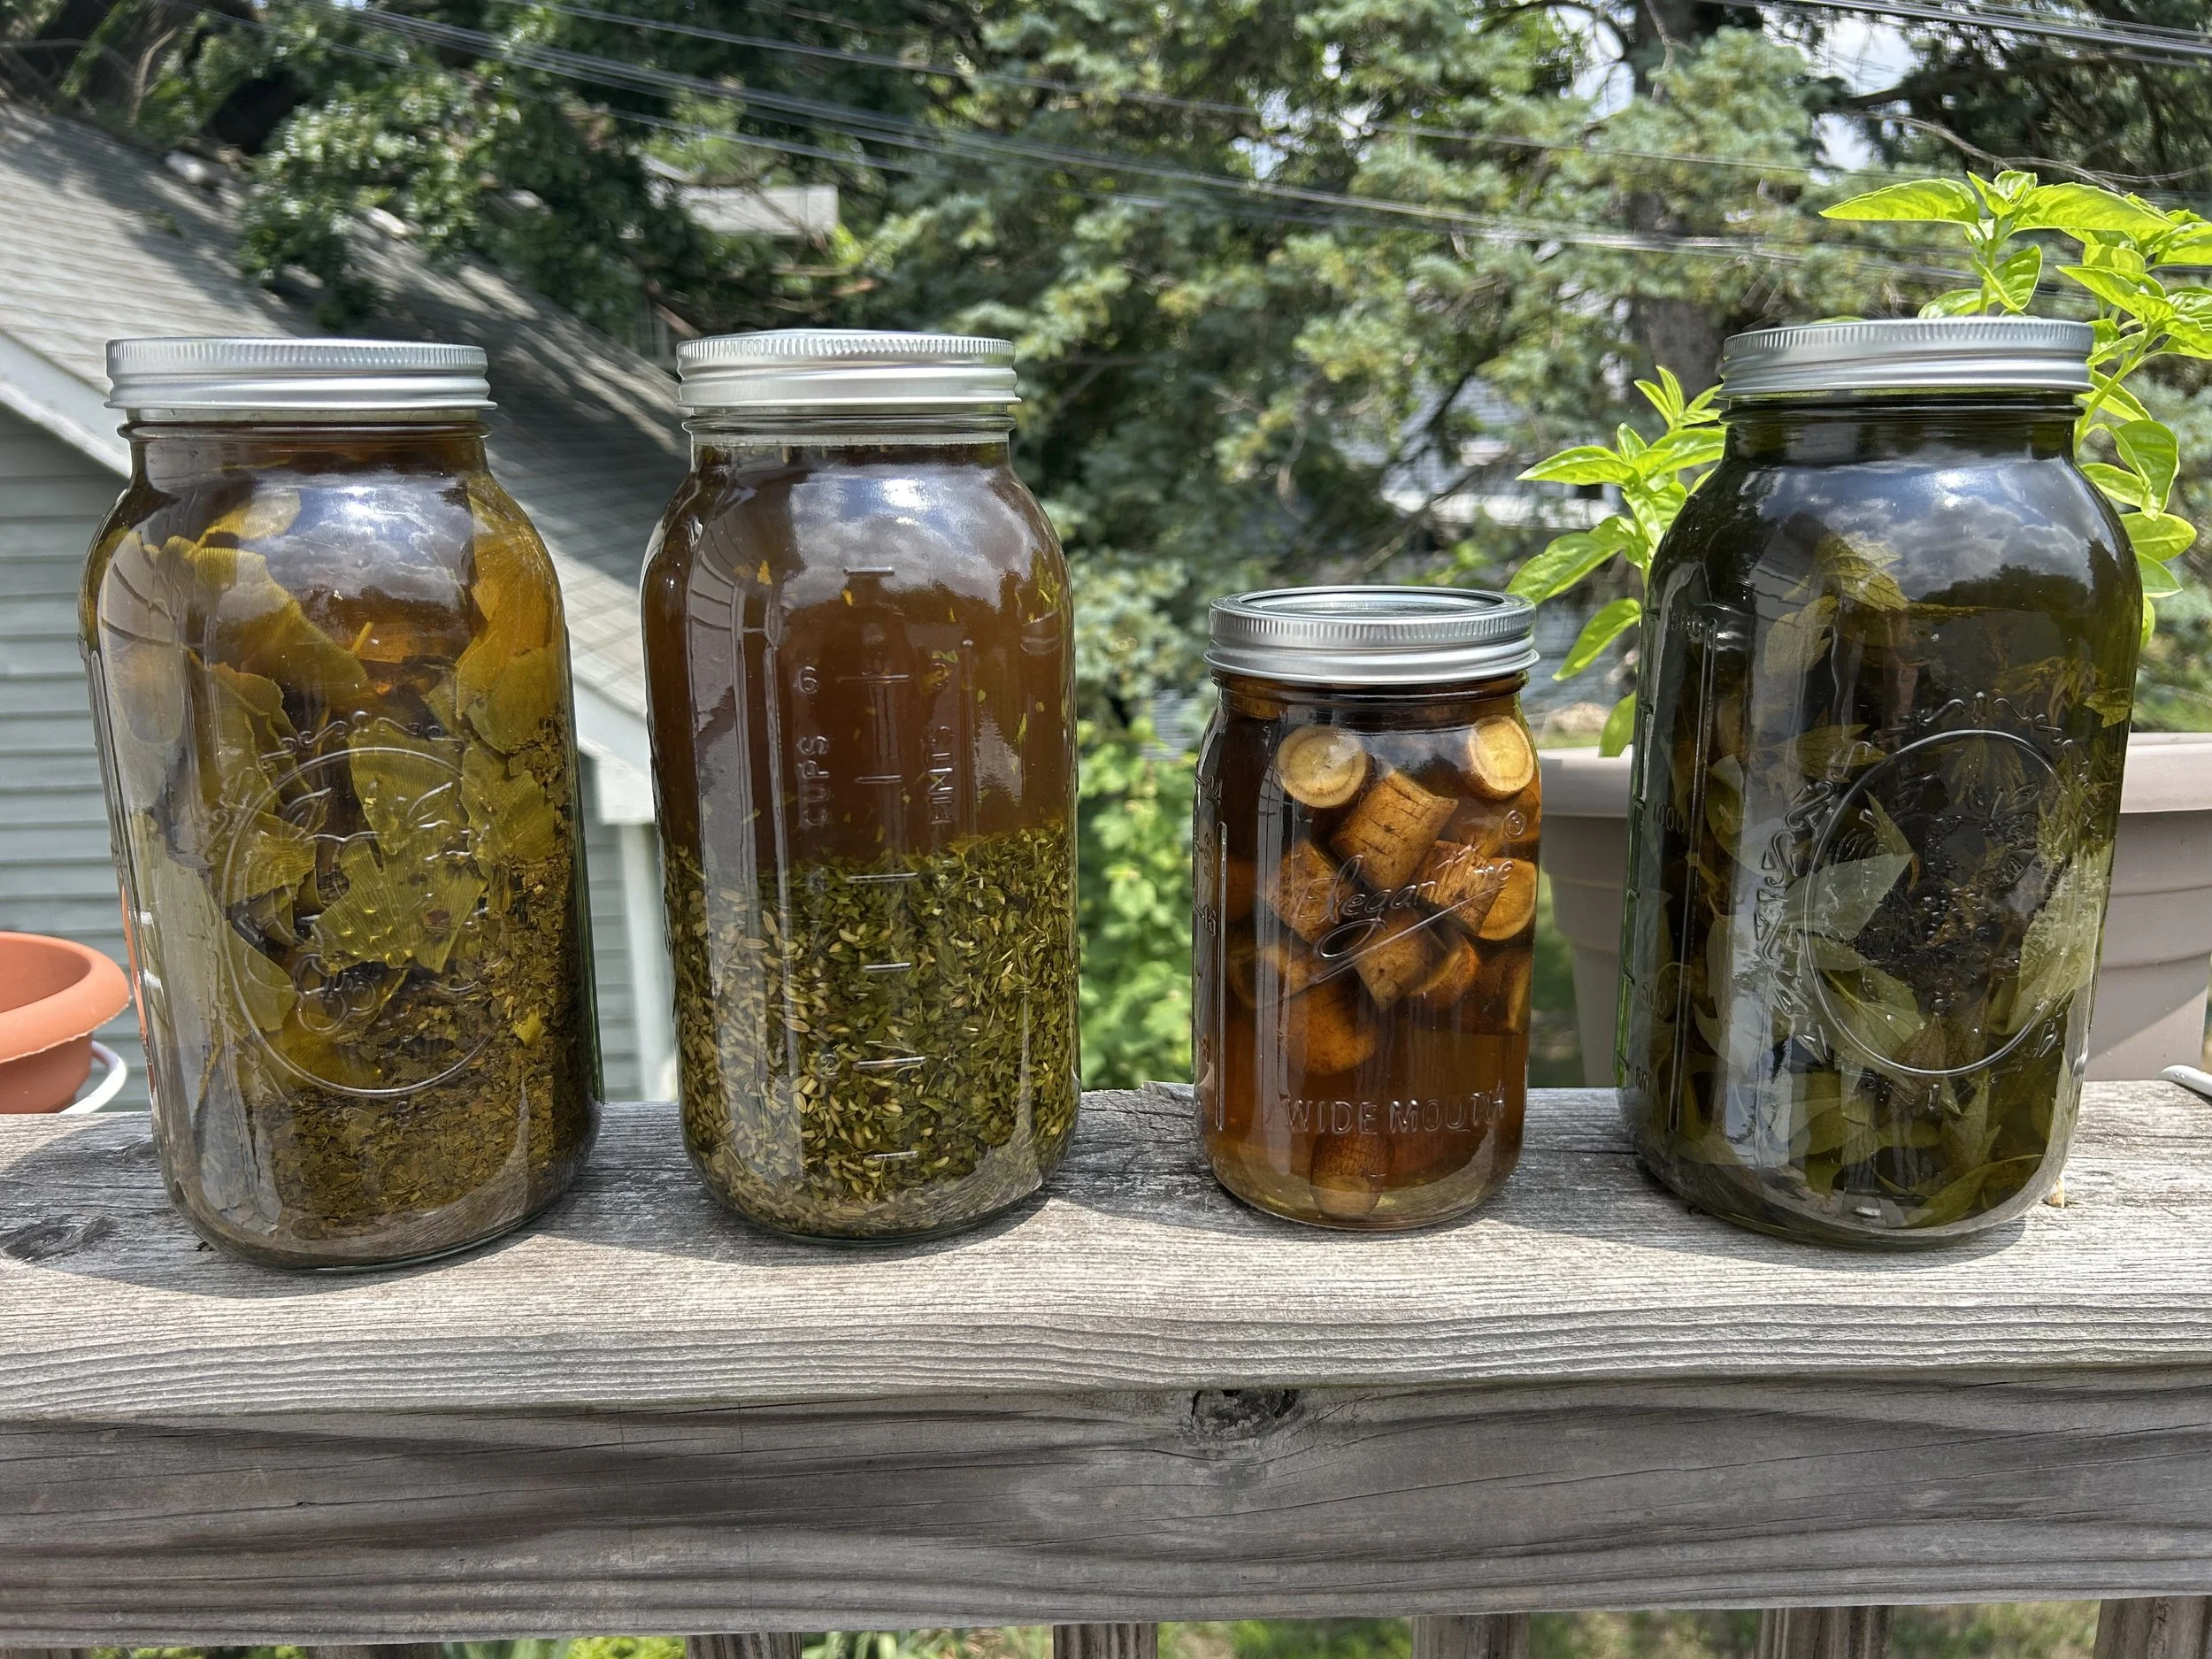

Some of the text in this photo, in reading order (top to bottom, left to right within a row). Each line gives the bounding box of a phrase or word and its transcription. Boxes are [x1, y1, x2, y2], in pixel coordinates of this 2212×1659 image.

[798, 665, 818, 695] 6
[798, 733, 830, 826] CUPS
[929, 725, 954, 826] PINTS
[1653, 799, 1686, 835] 1000
[1641, 980, 1668, 1015] 500
[1284, 1086, 1505, 1136] WIDE MOUTH
